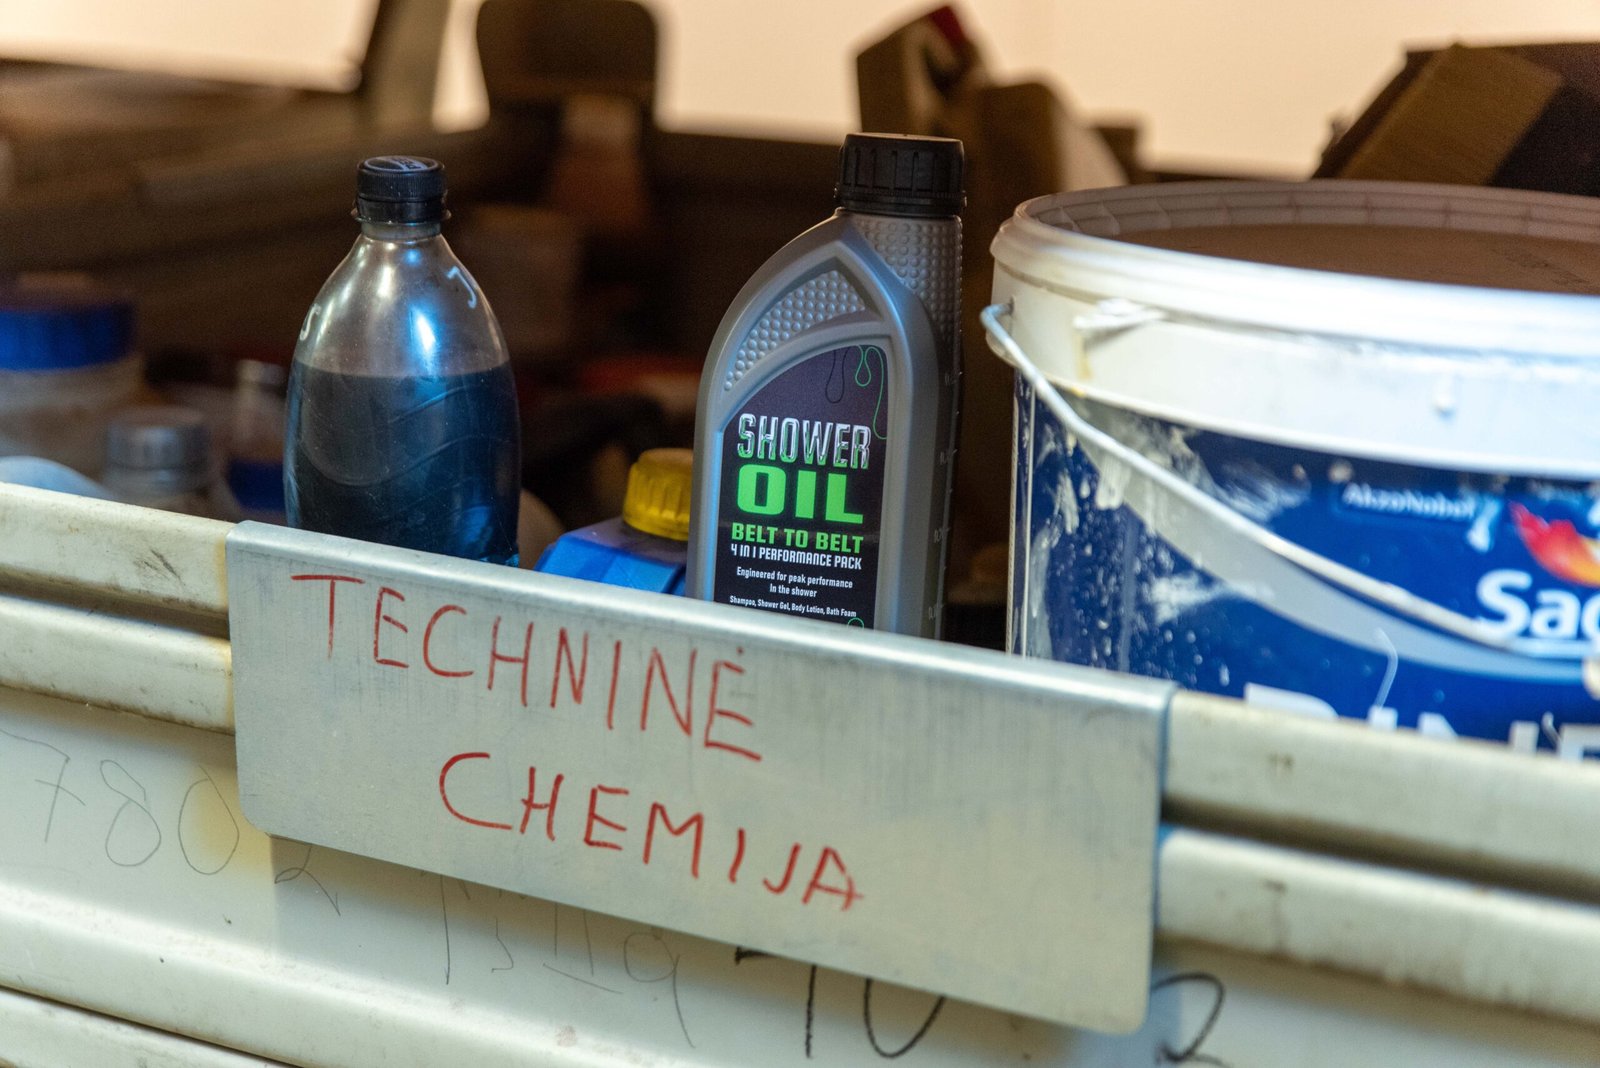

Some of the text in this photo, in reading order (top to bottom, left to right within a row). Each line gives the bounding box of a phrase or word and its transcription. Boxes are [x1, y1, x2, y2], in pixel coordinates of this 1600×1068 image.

[737, 413, 872, 469] SHOWER
[737, 464, 864, 524] OIL
[731, 522, 864, 554] BELT TO BELT
[730, 543, 738, 556] 4
[740, 545, 750, 558] IN
[759, 547, 832, 567] PERFORMANCE
[834, 556, 862, 570] PACK
[736, 566, 853, 589] Engineered for peak performance
[778, 585, 790, 595] the
[791, 587, 818, 598] shower
[729, 595, 857, 618] Shampoo, Shower Gel, Body Lotion, Bath Foam
[291, 574, 762, 762] TECHNINĖ
[439, 751, 864, 911] CHEMIJA
